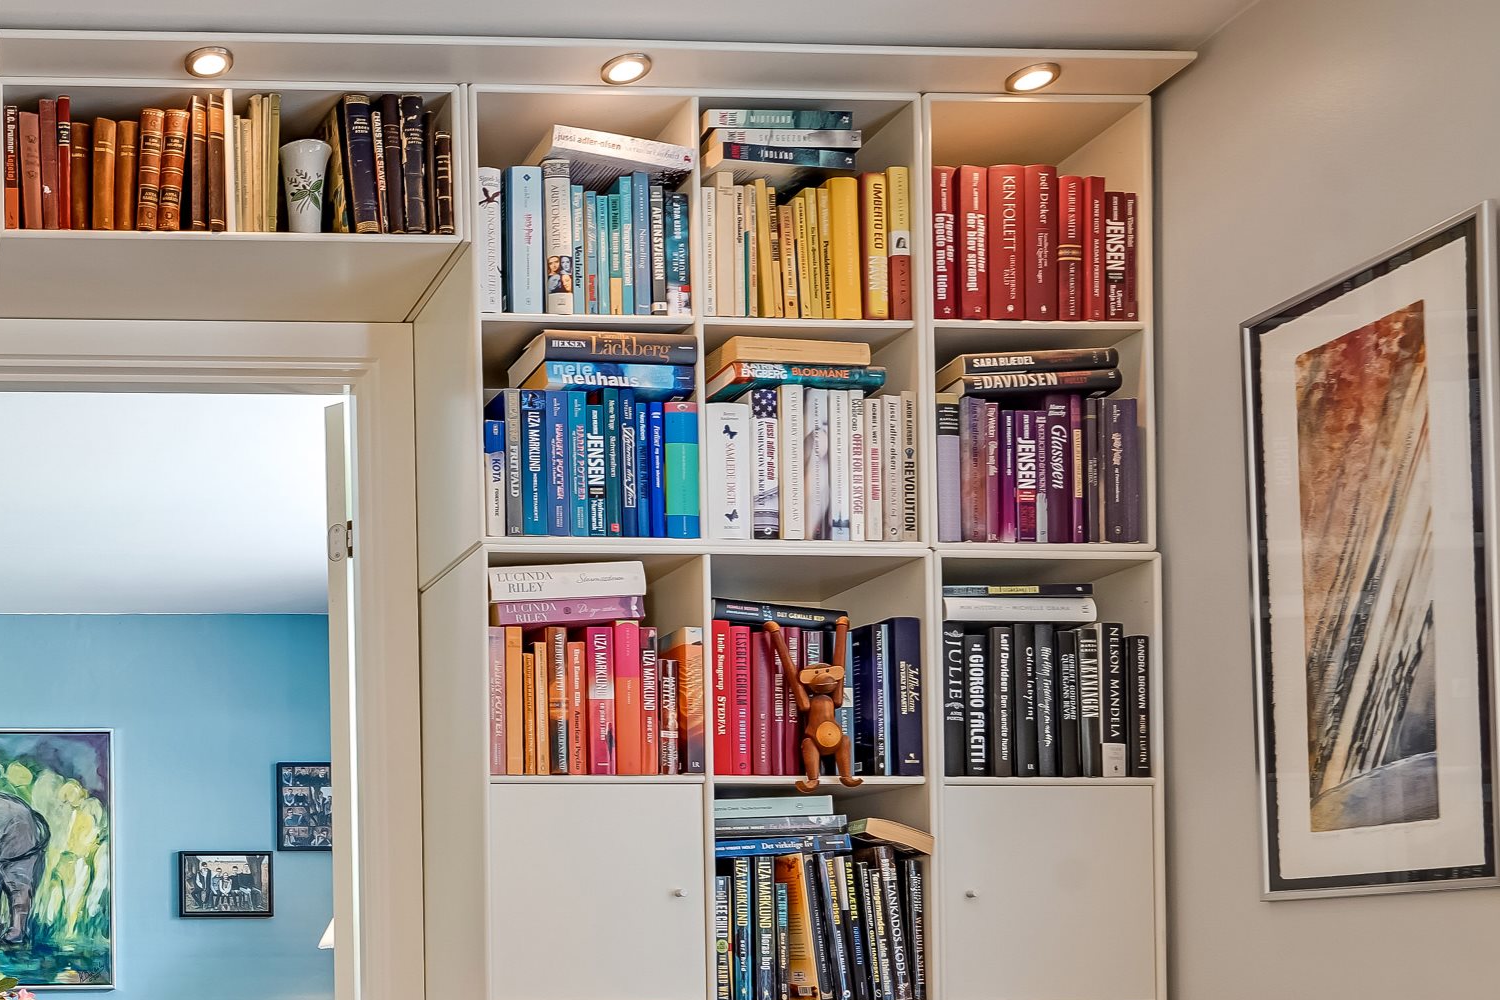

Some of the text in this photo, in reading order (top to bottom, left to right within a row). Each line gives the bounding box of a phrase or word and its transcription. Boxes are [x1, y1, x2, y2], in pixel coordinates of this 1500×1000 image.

[873, 183, 883, 249] UMBERTO ECO
[1003, 176, 1015, 251] KEN FOLLETT
[638, 229, 646, 268] Nedtælling
[1106, 220, 1124, 270] JENSEN
[552, 363, 593, 376] nele
[590, 335, 671, 363] Läckberg
[562, 372, 639, 387] neuhaus
[983, 372, 1057, 388] DAVIDSEN
[528, 412, 540, 471] LIZA MARKLUND
[588, 434, 604, 484] JENSEN
[1018, 437, 1035, 489] JENSEN
[1050, 425, 1066, 489] Glassøen
[904, 462, 915, 531] REVOLUTION
[508, 582, 544, 593] RILEY
[643, 650, 655, 710] LIZA MARKLUND
[946, 640, 961, 698] JULIE
[1110, 628, 1120, 737] NELSON MANDELA
[1137, 639, 1145, 673] SANDRA
[970, 655, 984, 762] GIORGIO FALETTI
[759, 862, 771, 928] LIZA MARKLUND
[887, 883, 906, 976] TANKADOS KODE
